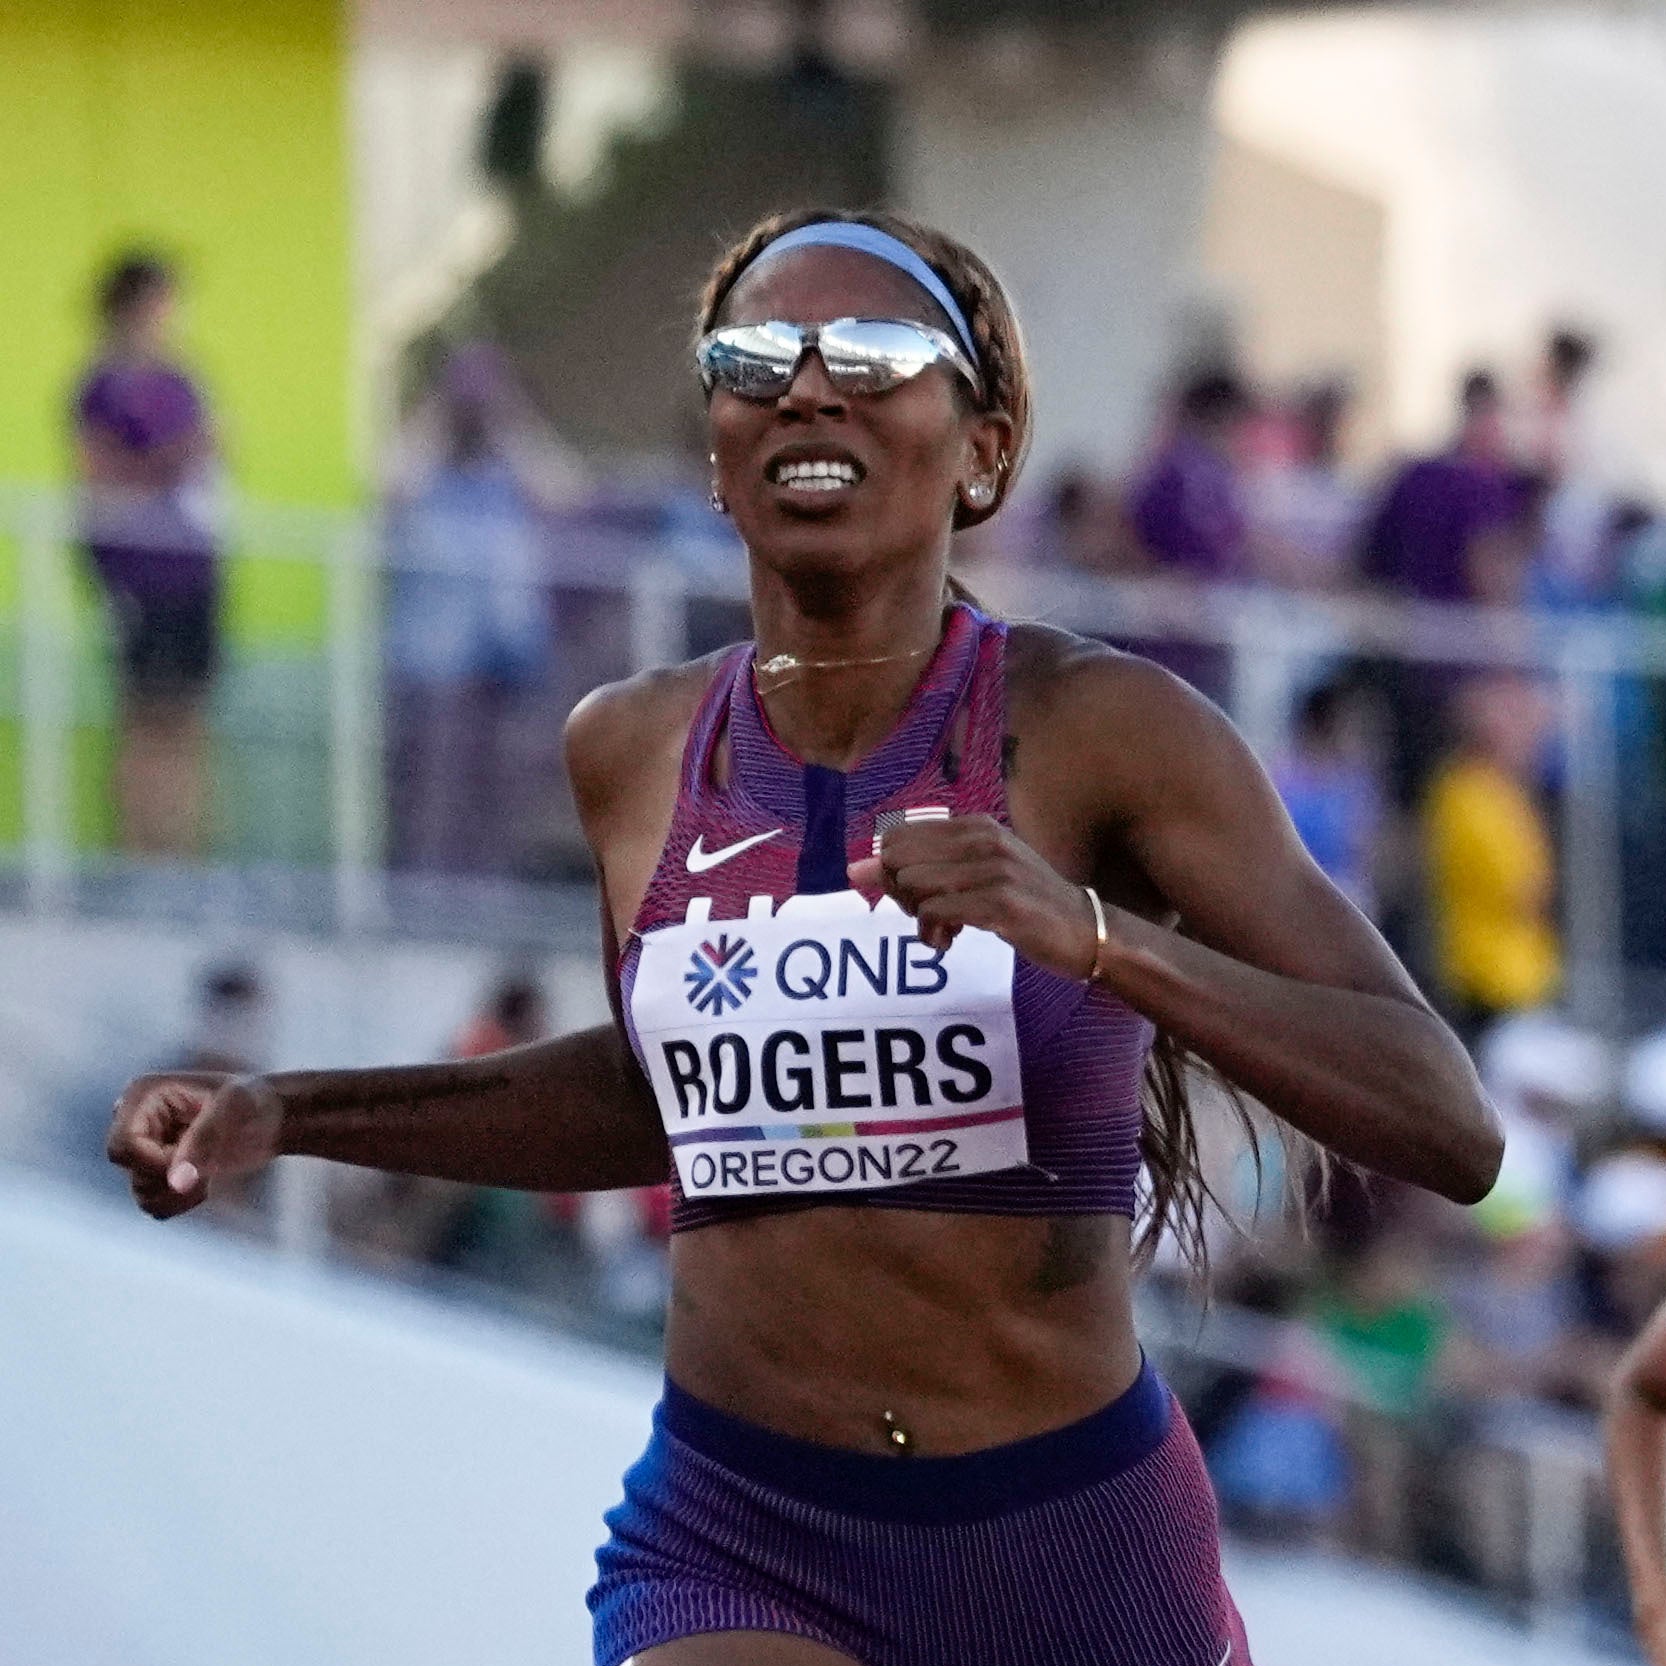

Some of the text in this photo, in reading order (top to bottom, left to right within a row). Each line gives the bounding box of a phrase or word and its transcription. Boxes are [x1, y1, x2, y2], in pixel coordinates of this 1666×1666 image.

[775, 935, 949, 1000] QNB
[661, 1024, 992, 1119] ROGERS
[691, 1139, 960, 1189] OREGON22
